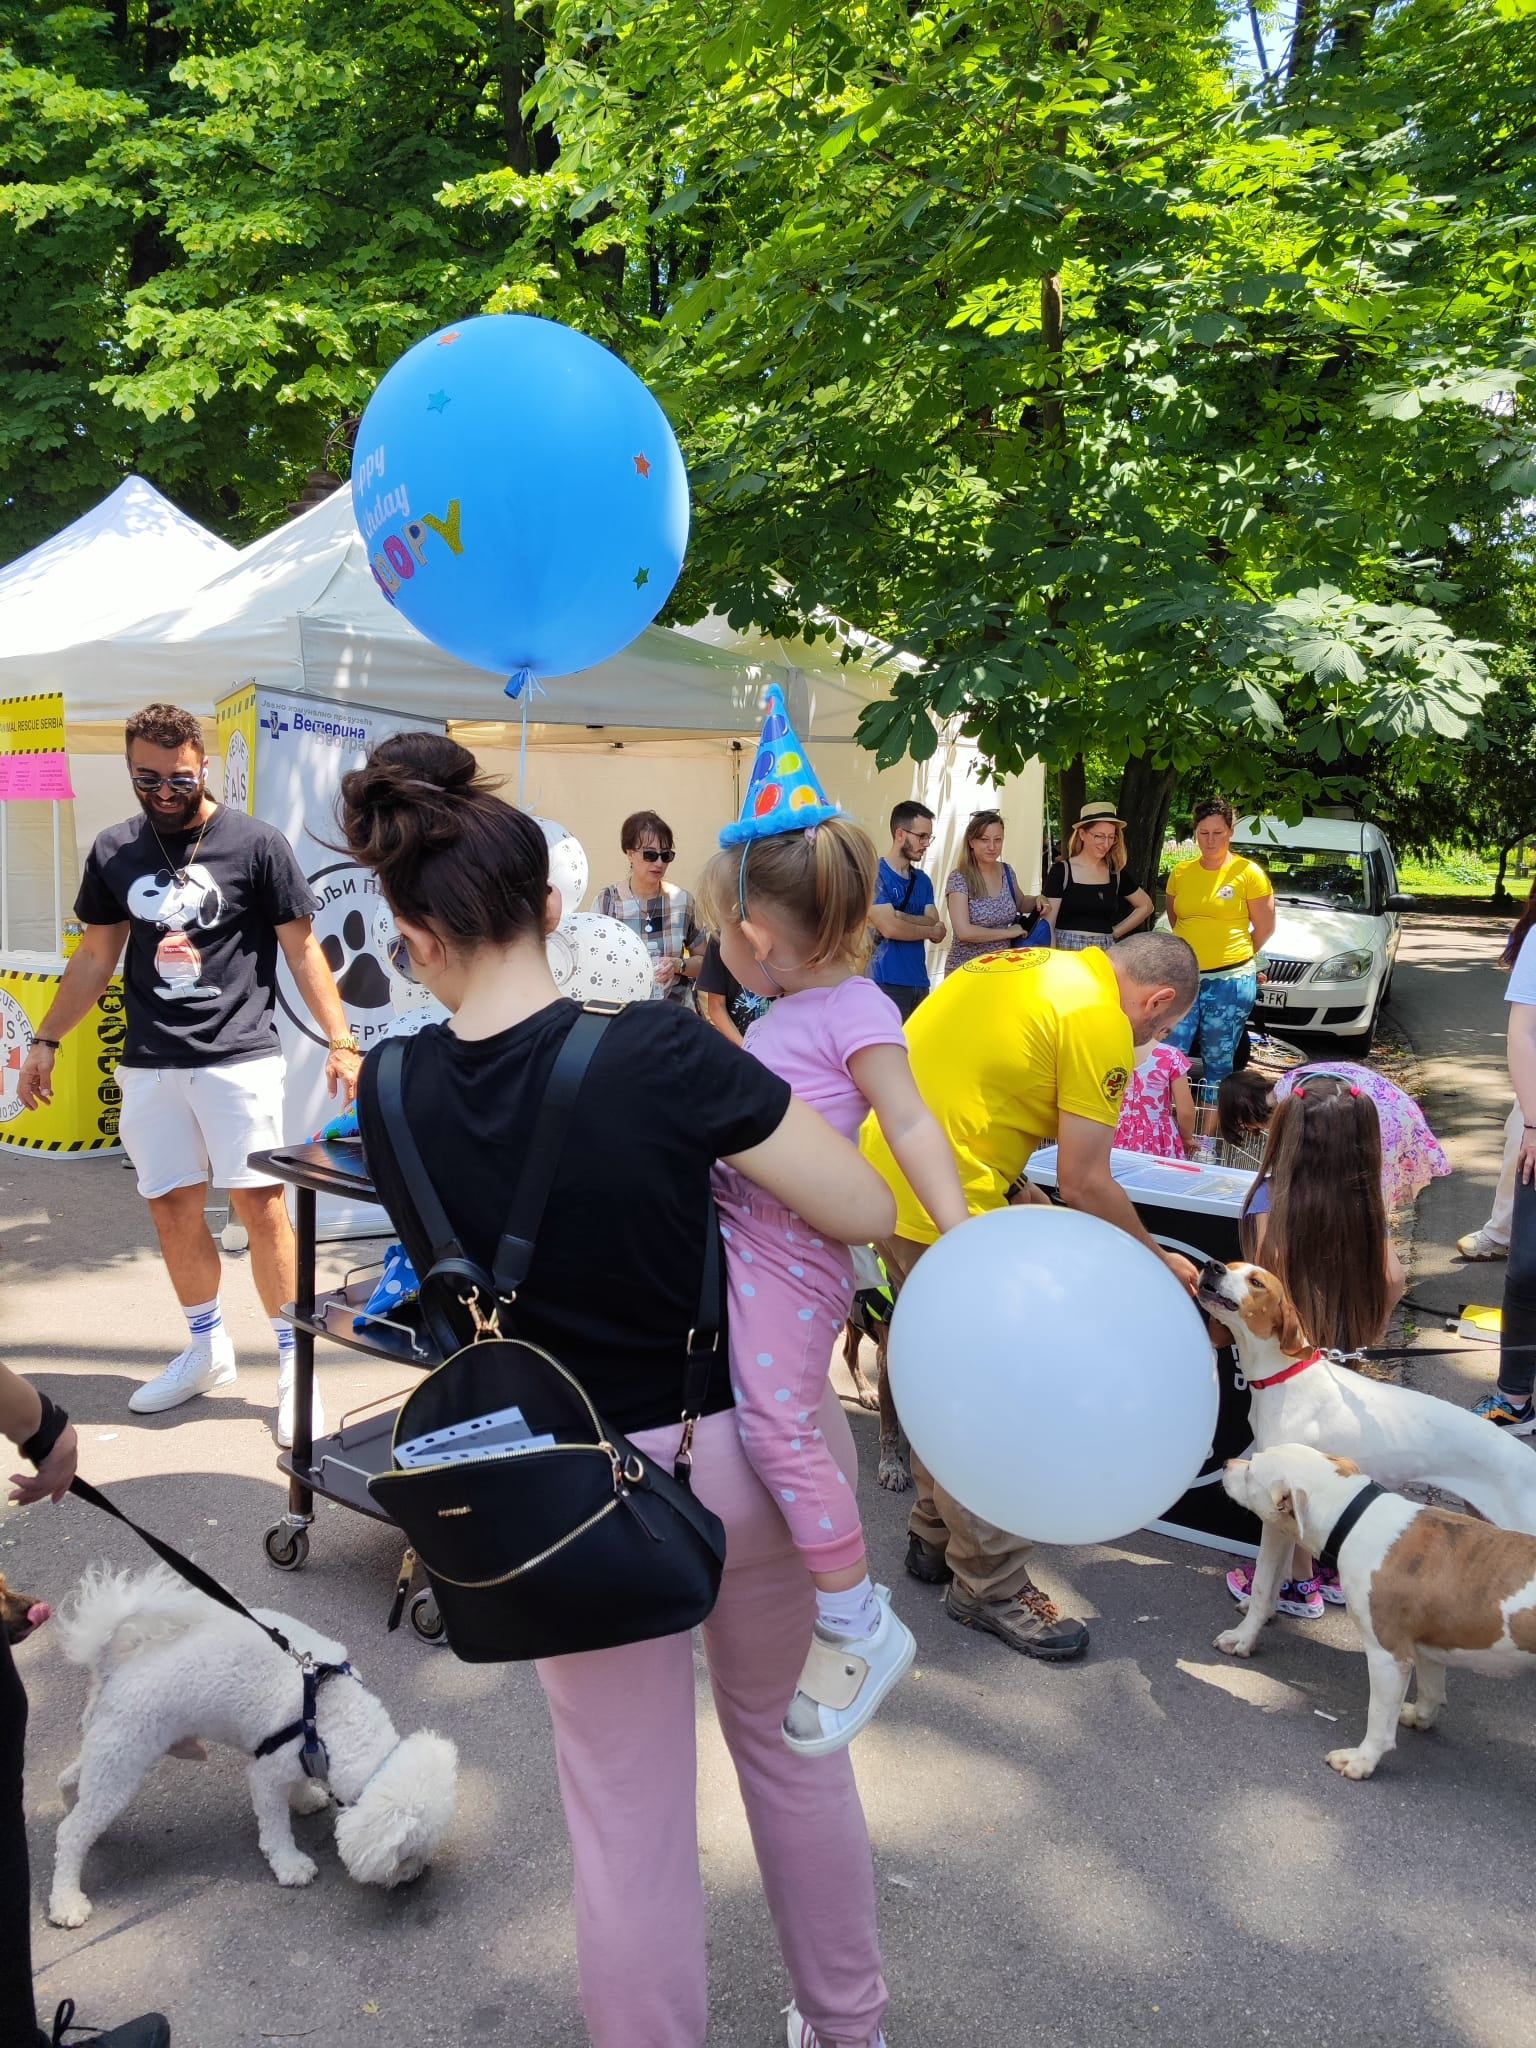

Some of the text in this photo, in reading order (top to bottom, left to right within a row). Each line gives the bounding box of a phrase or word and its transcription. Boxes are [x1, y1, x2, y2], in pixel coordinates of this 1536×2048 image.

[358, 444, 386, 496] ppy
[364, 483, 410, 540] hday
[371, 498, 464, 604] OOPY
[17, 719, 40, 732] RESCUE
[40, 717, 64, 730] SERBIA
[311, 878, 357, 922] ОЉИ
